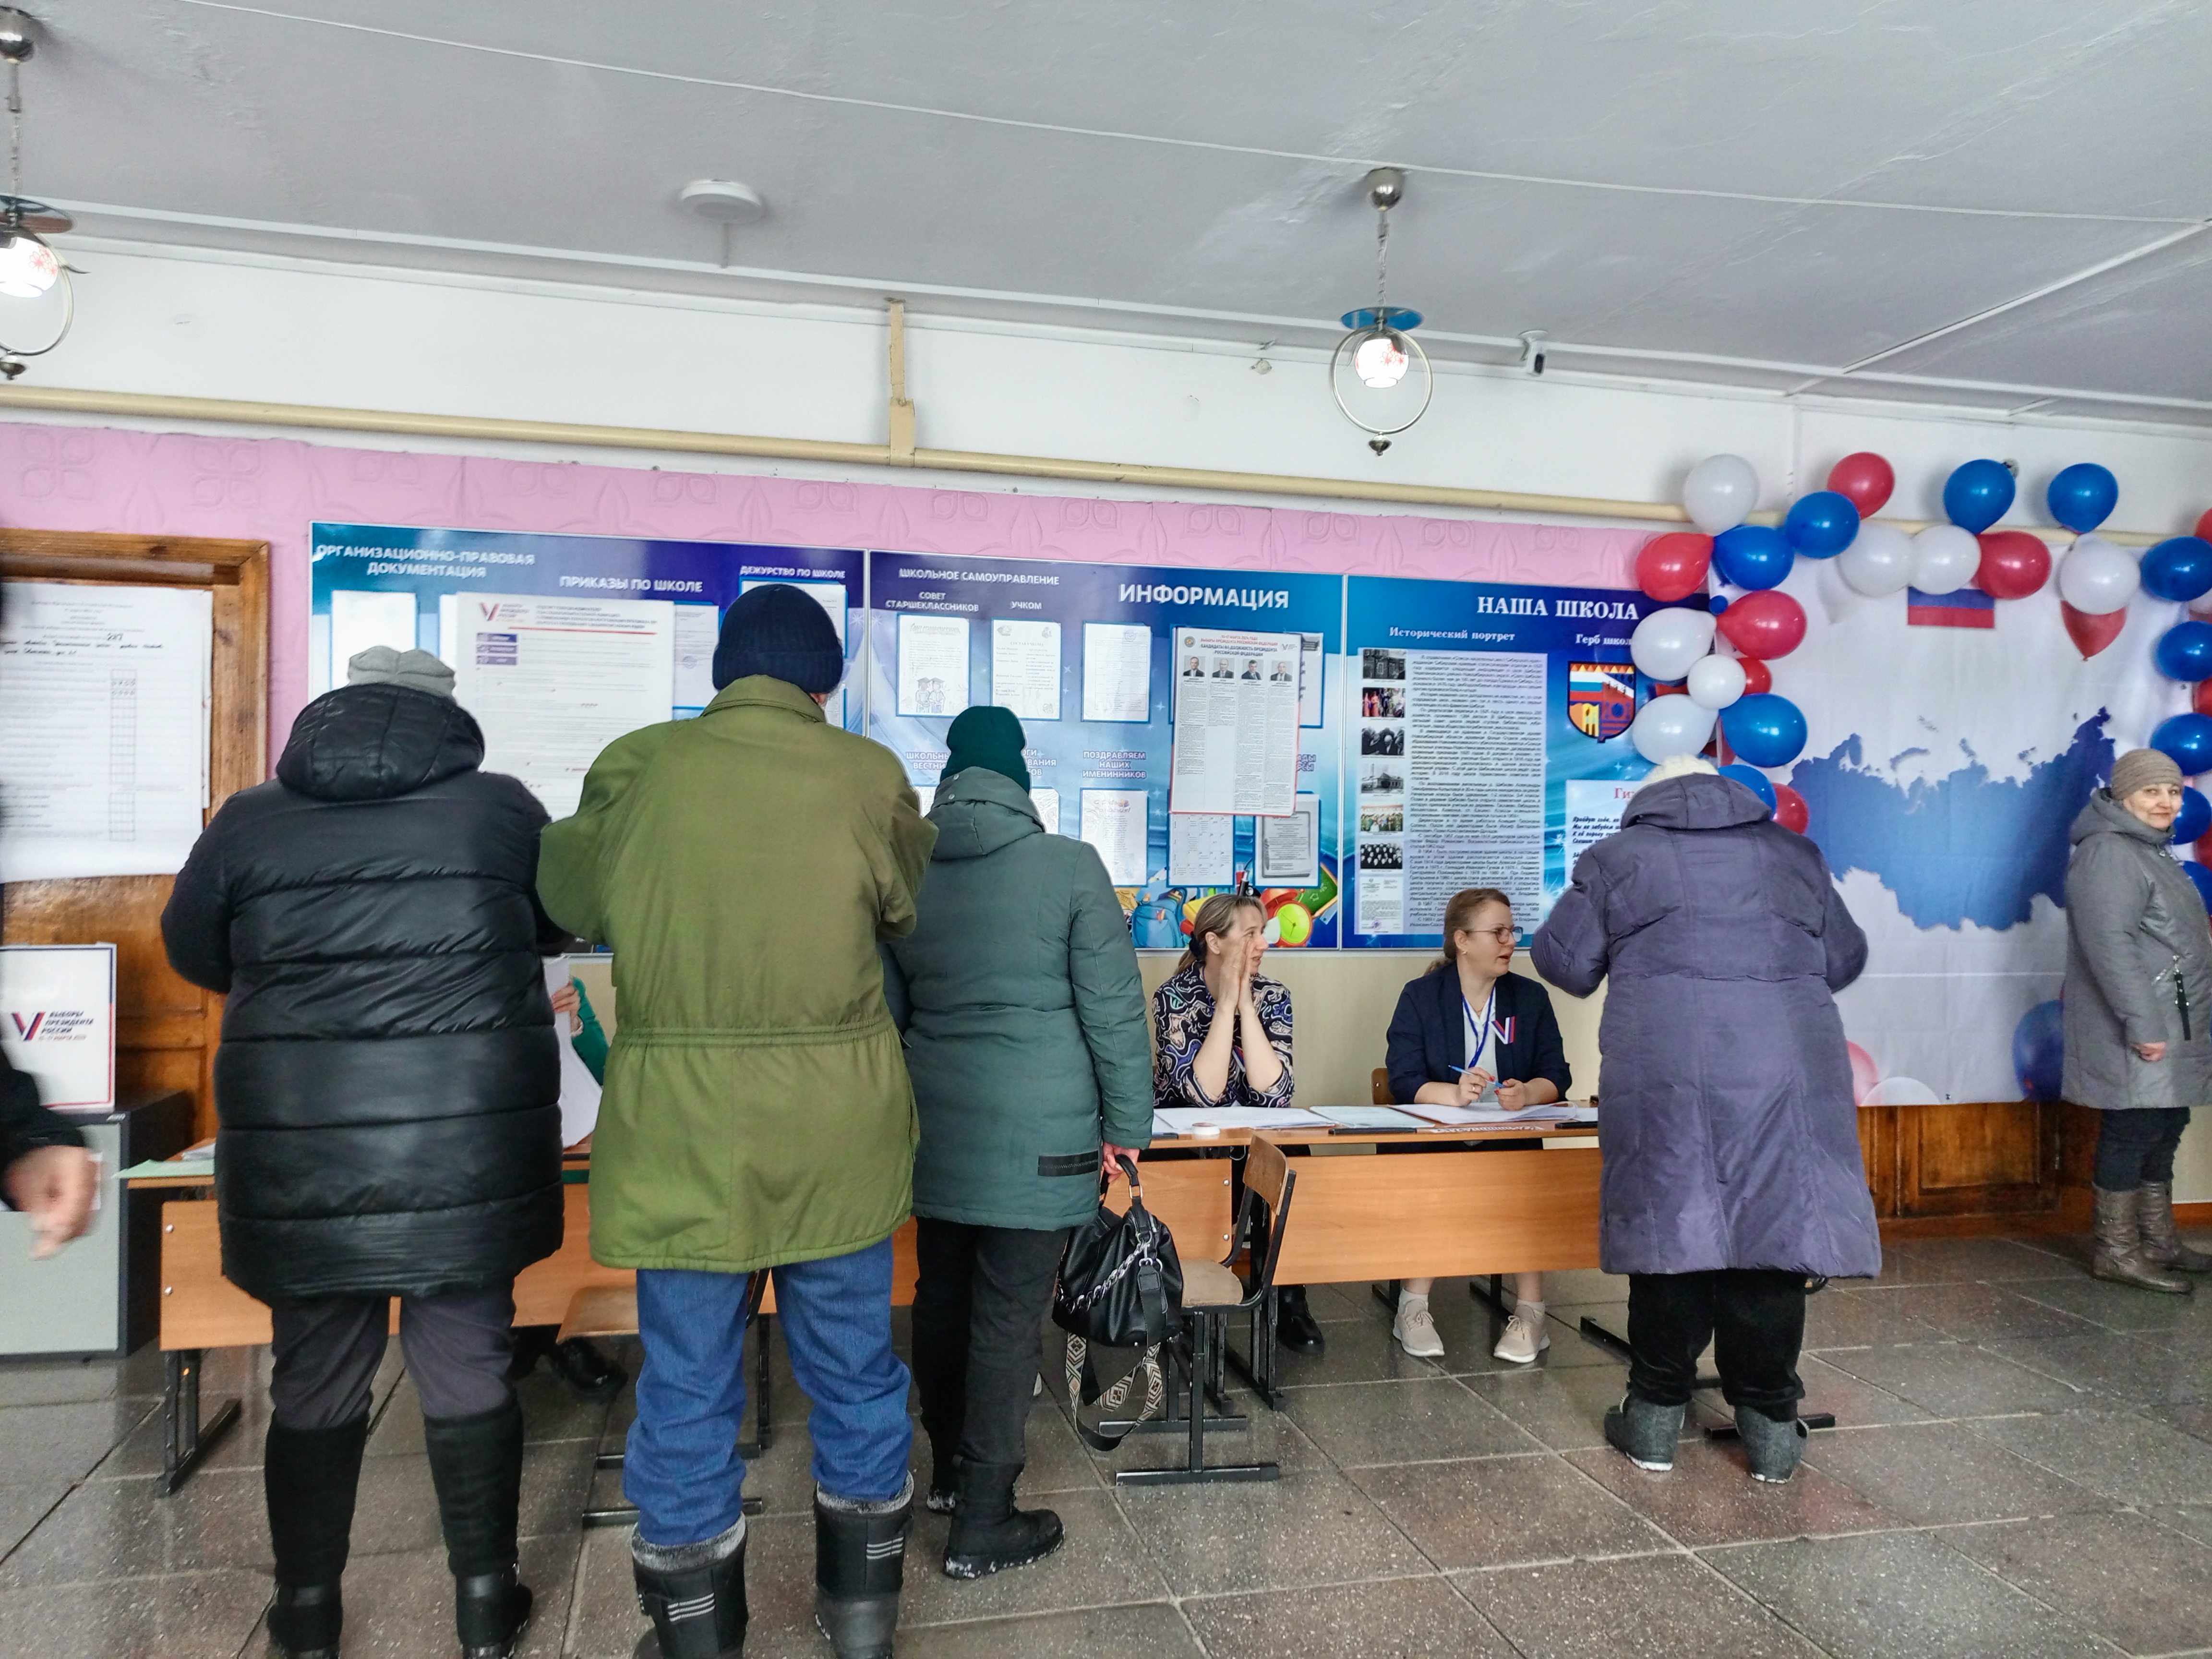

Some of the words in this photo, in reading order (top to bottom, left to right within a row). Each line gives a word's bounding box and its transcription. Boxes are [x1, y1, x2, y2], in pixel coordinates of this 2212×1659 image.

[317, 545, 535, 565] ОРГАНИЗАЦИОННО-ПРАВОВАЯ
[367, 562, 486, 579] ДОКУМЕНТАЦИЯ
[740, 565, 795, 576] ДЕЖУРСТВО
[797, 569, 811, 577] ПО
[812, 569, 845, 578] ШКОЛЕ
[899, 568, 960, 580] ШКОЛЬНОЕ
[961, 571, 1060, 585] САМОУПРАВЛЕНИЕ
[560, 576, 628, 590] ПРИКАЗЫ
[630, 579, 651, 590] ПО
[653, 580, 703, 593] ШКОЛЕ
[919, 591, 946, 600] СОВЕТ
[1119, 584, 1289, 611] ИНФОРМАЦИЯ
[885, 600, 979, 612] СТАРШЕКЛАССНИКОВ
[1010, 601, 1042, 610] УЧКОМ
[1477, 596, 1549, 616] НАША
[1554, 600, 1639, 620] ШКОЛА
[1389, 626, 1468, 639] Исторический
[1471, 631, 1515, 642] портрет
[1575, 634, 1600, 646] Герб
[1083, 751, 1146, 760] ПОЗДРАВЛЯЕМ
[913, 762, 946, 770] ВЕСТНИ
[1027, 758, 1057, 767] ВАНИЯ
[1099, 761, 1131, 769] НАШИХ
[1082, 770, 1146, 779] ИМЕНИННИКОВ
[48, 1010, 84, 1018] ВЫБОРЫ
[45, 1018, 94, 1026] ПРЕЗИДЕНТА
